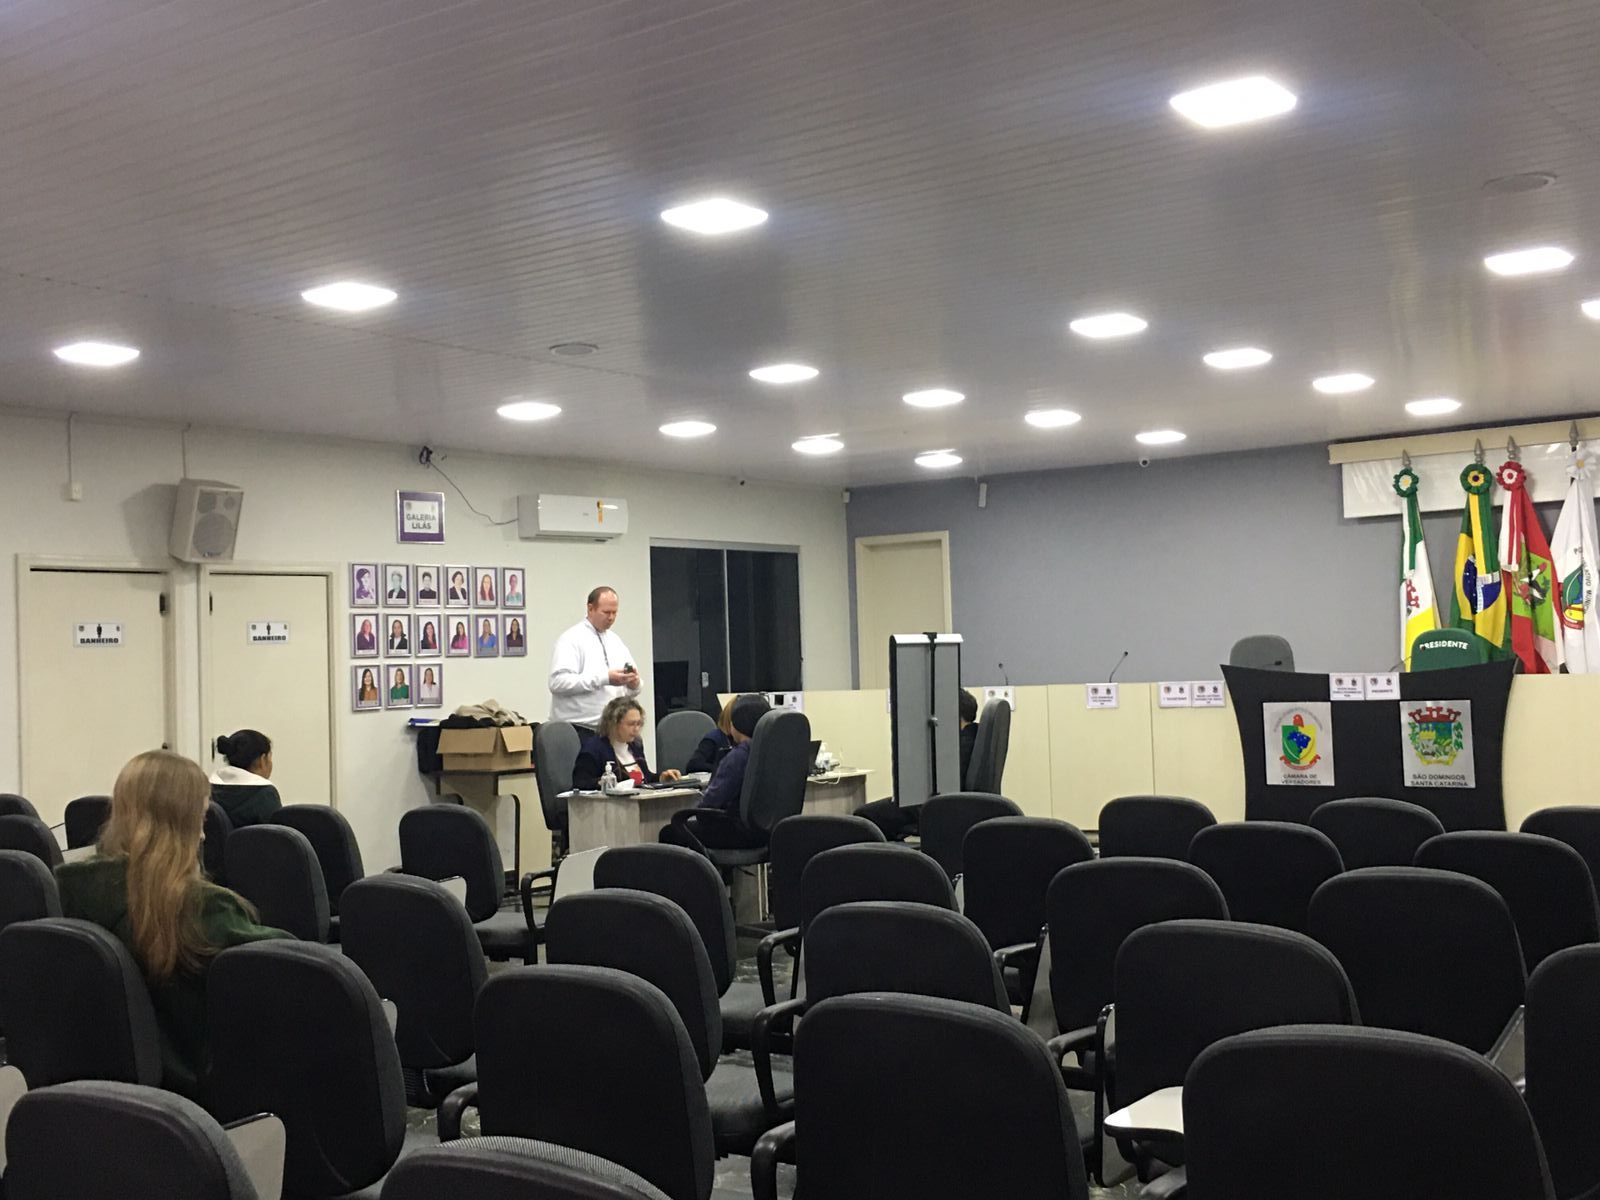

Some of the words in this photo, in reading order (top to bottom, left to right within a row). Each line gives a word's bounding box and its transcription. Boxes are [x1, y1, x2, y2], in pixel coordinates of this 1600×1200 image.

[406, 513, 437, 521] GALERIA
[411, 521, 432, 530] LILÁS
[1419, 639, 1469, 650] PRESIDENTE
